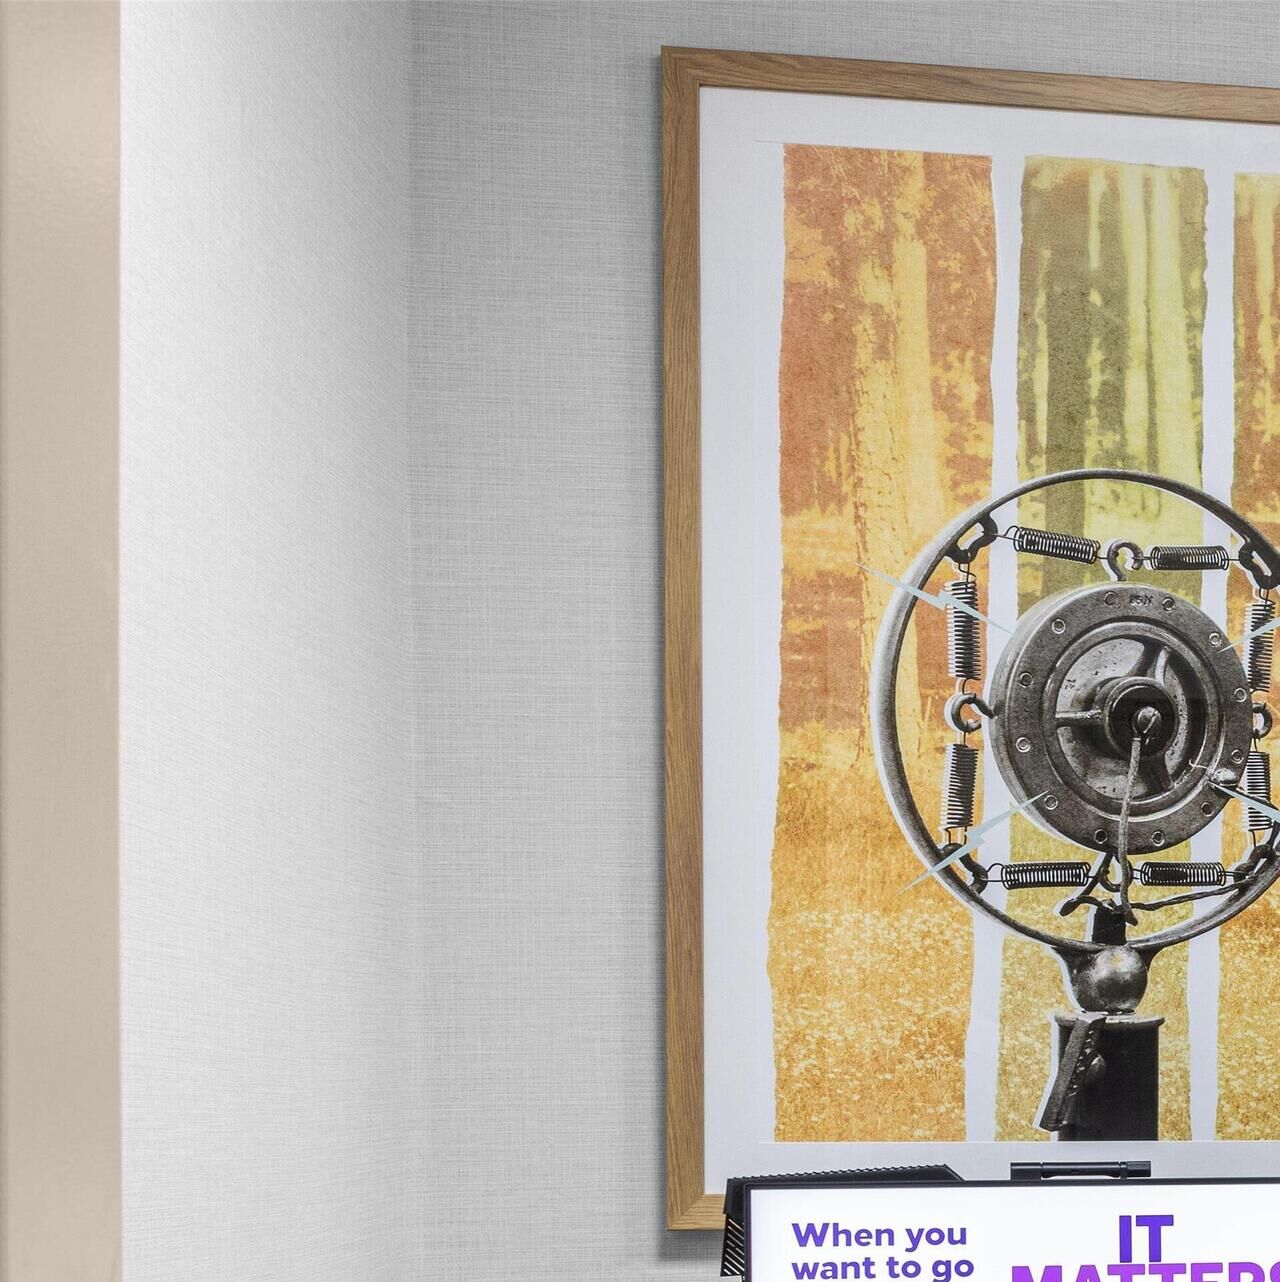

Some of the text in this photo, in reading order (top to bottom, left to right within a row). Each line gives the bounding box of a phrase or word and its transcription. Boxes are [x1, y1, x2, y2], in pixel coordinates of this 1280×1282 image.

[791, 1222, 967, 1253] When you
[1119, 1214, 1174, 1263] IT
[791, 1257, 876, 1280] want
[886, 1256, 921, 1279] to
